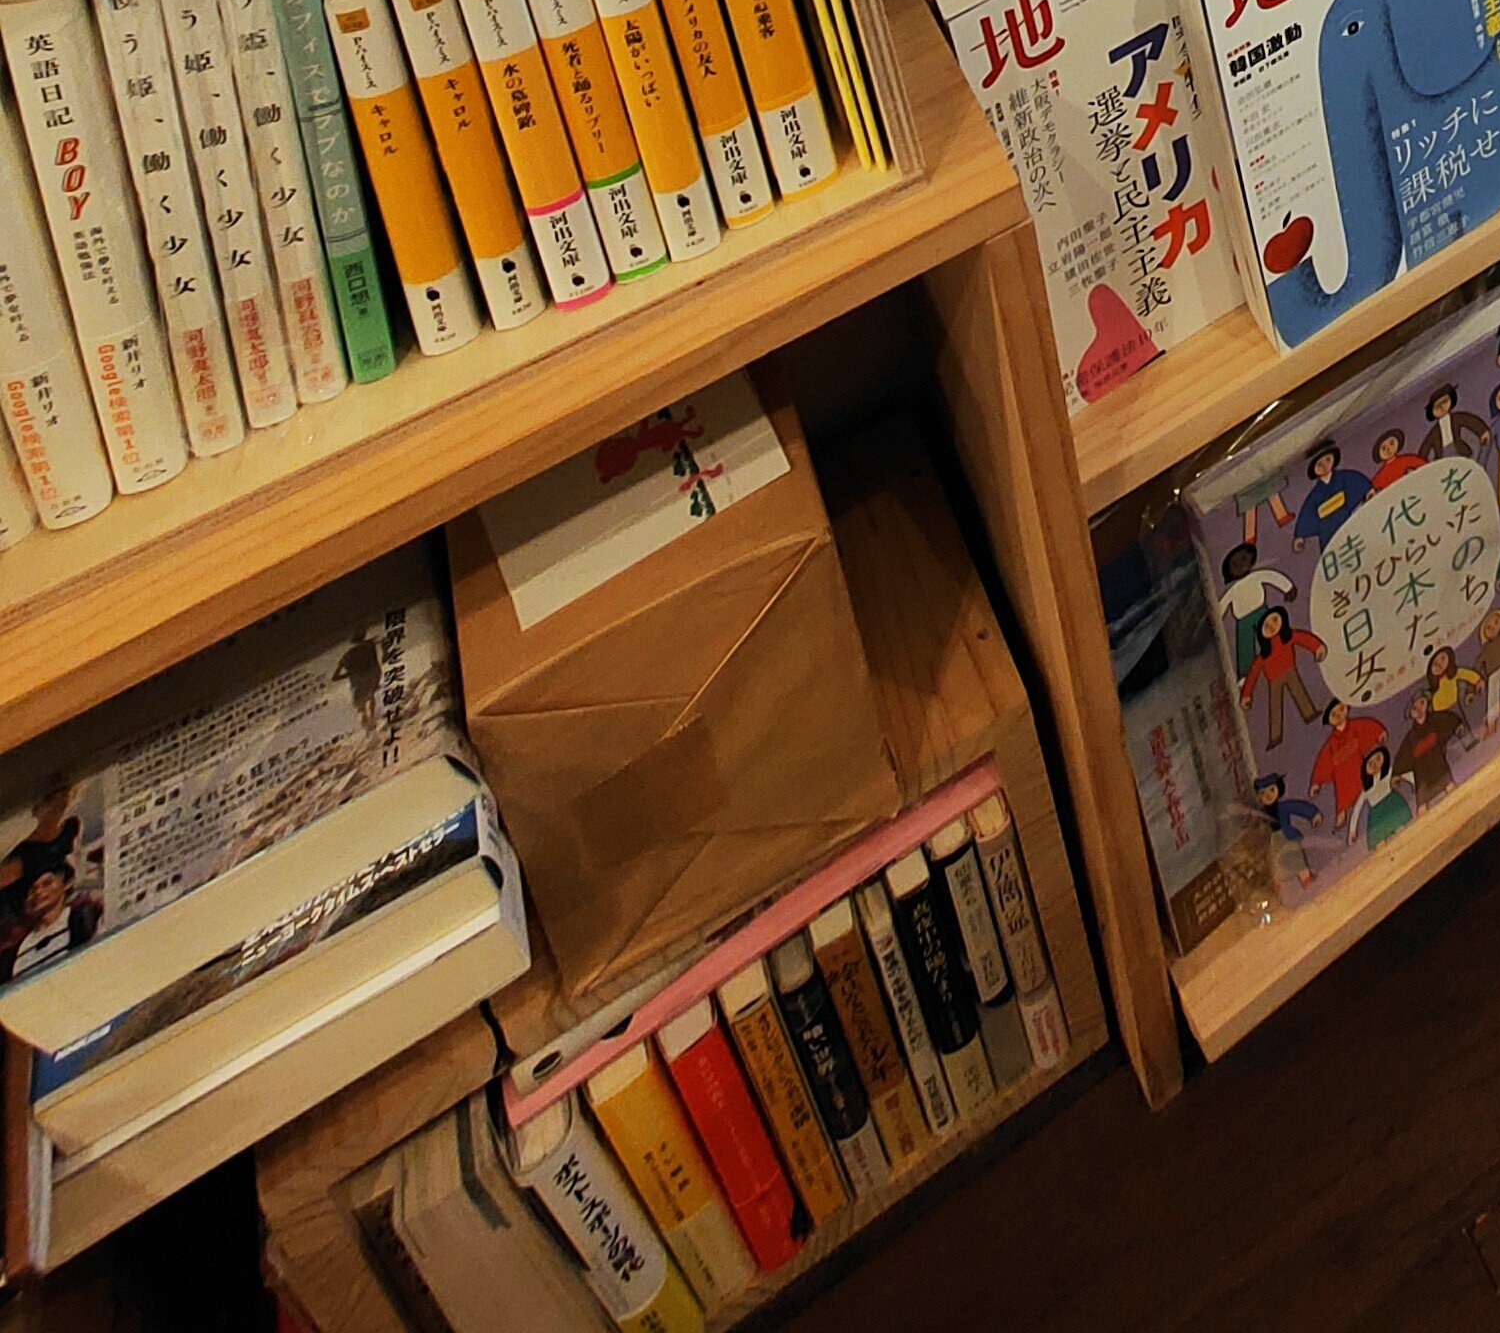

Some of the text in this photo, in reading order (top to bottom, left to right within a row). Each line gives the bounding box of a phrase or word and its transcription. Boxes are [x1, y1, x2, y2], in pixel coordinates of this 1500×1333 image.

[25, 33, 73, 128] 英語日記
[1229, 23, 1303, 77] 韓国激動
[54, 136, 91, 223] BOY
[1009, 87, 1057, 213] 維新政治の次へ
[1109, 20, 1212, 270] アメリカ
[1394, 89, 1498, 175] リッチに
[1086, 86, 1172, 316] 選挙と民主主義
